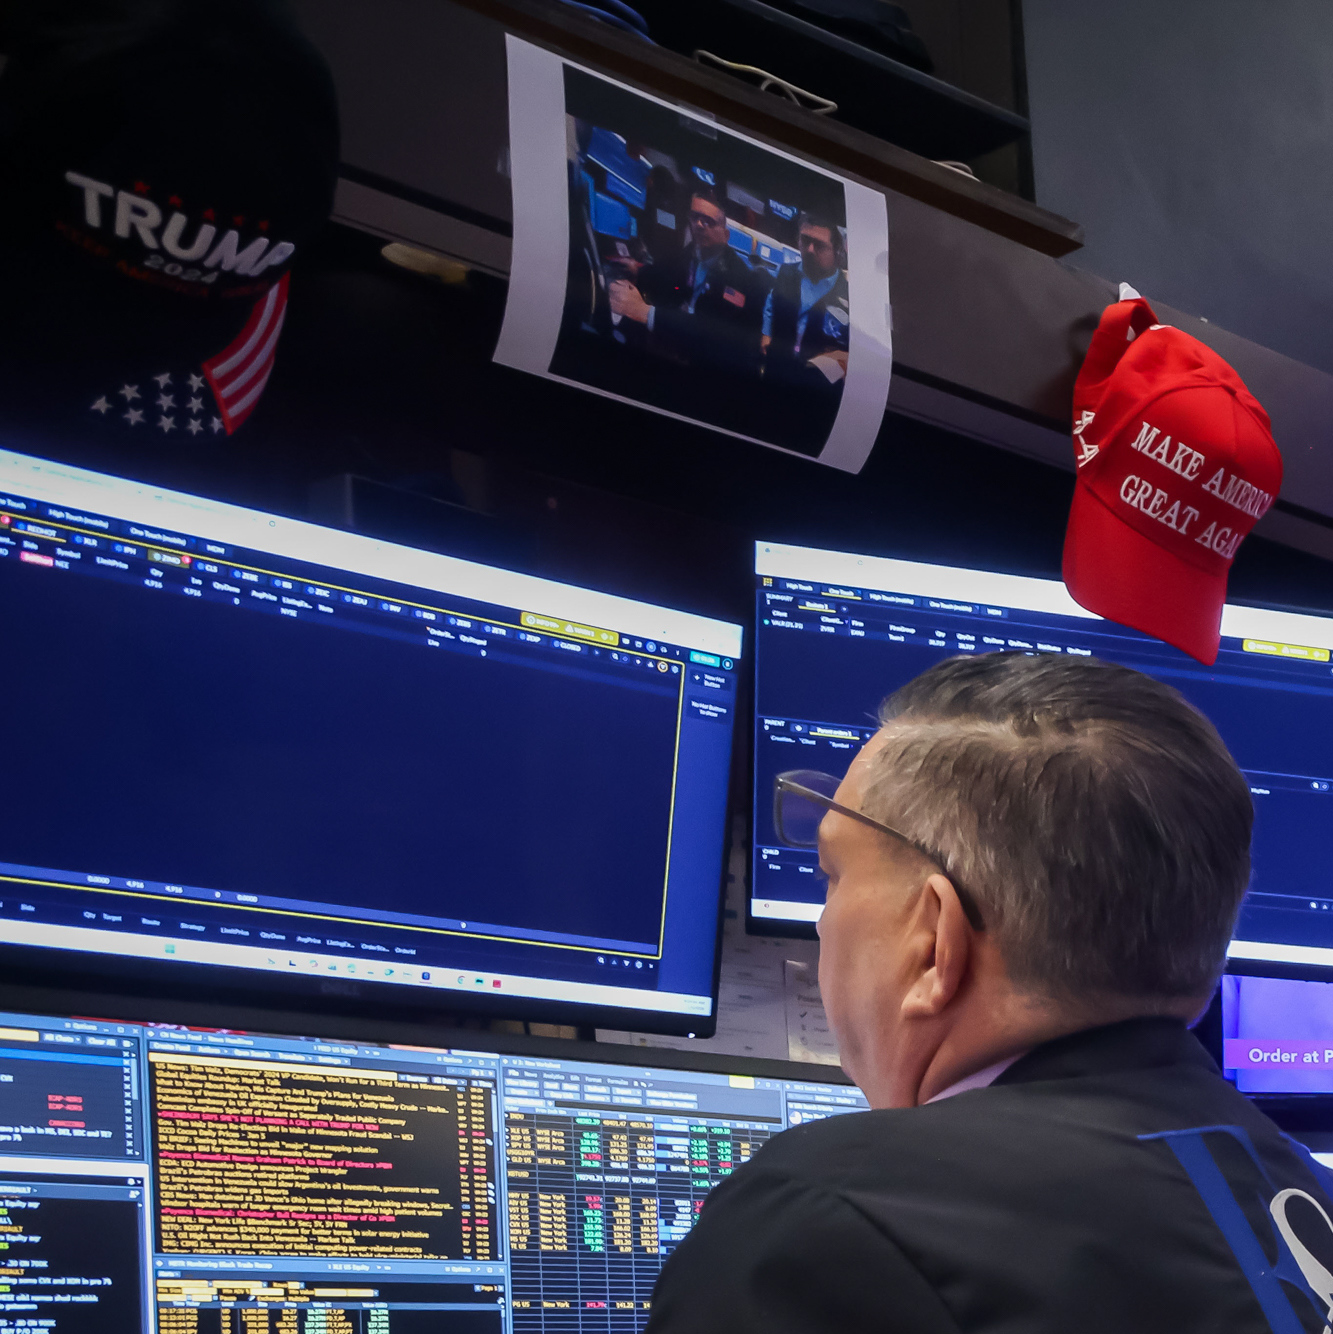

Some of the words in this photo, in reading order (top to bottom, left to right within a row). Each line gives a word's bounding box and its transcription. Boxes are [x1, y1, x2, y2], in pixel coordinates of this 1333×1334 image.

[65, 171, 295, 276] TRUMP
[1120, 475, 1199, 534] GREAT
[1131, 421, 1205, 481] MAKE
[1202, 468, 1273, 520] AMERIC
[1248, 1048, 1298, 1065] Order
[1303, 1050, 1319, 1065] at
